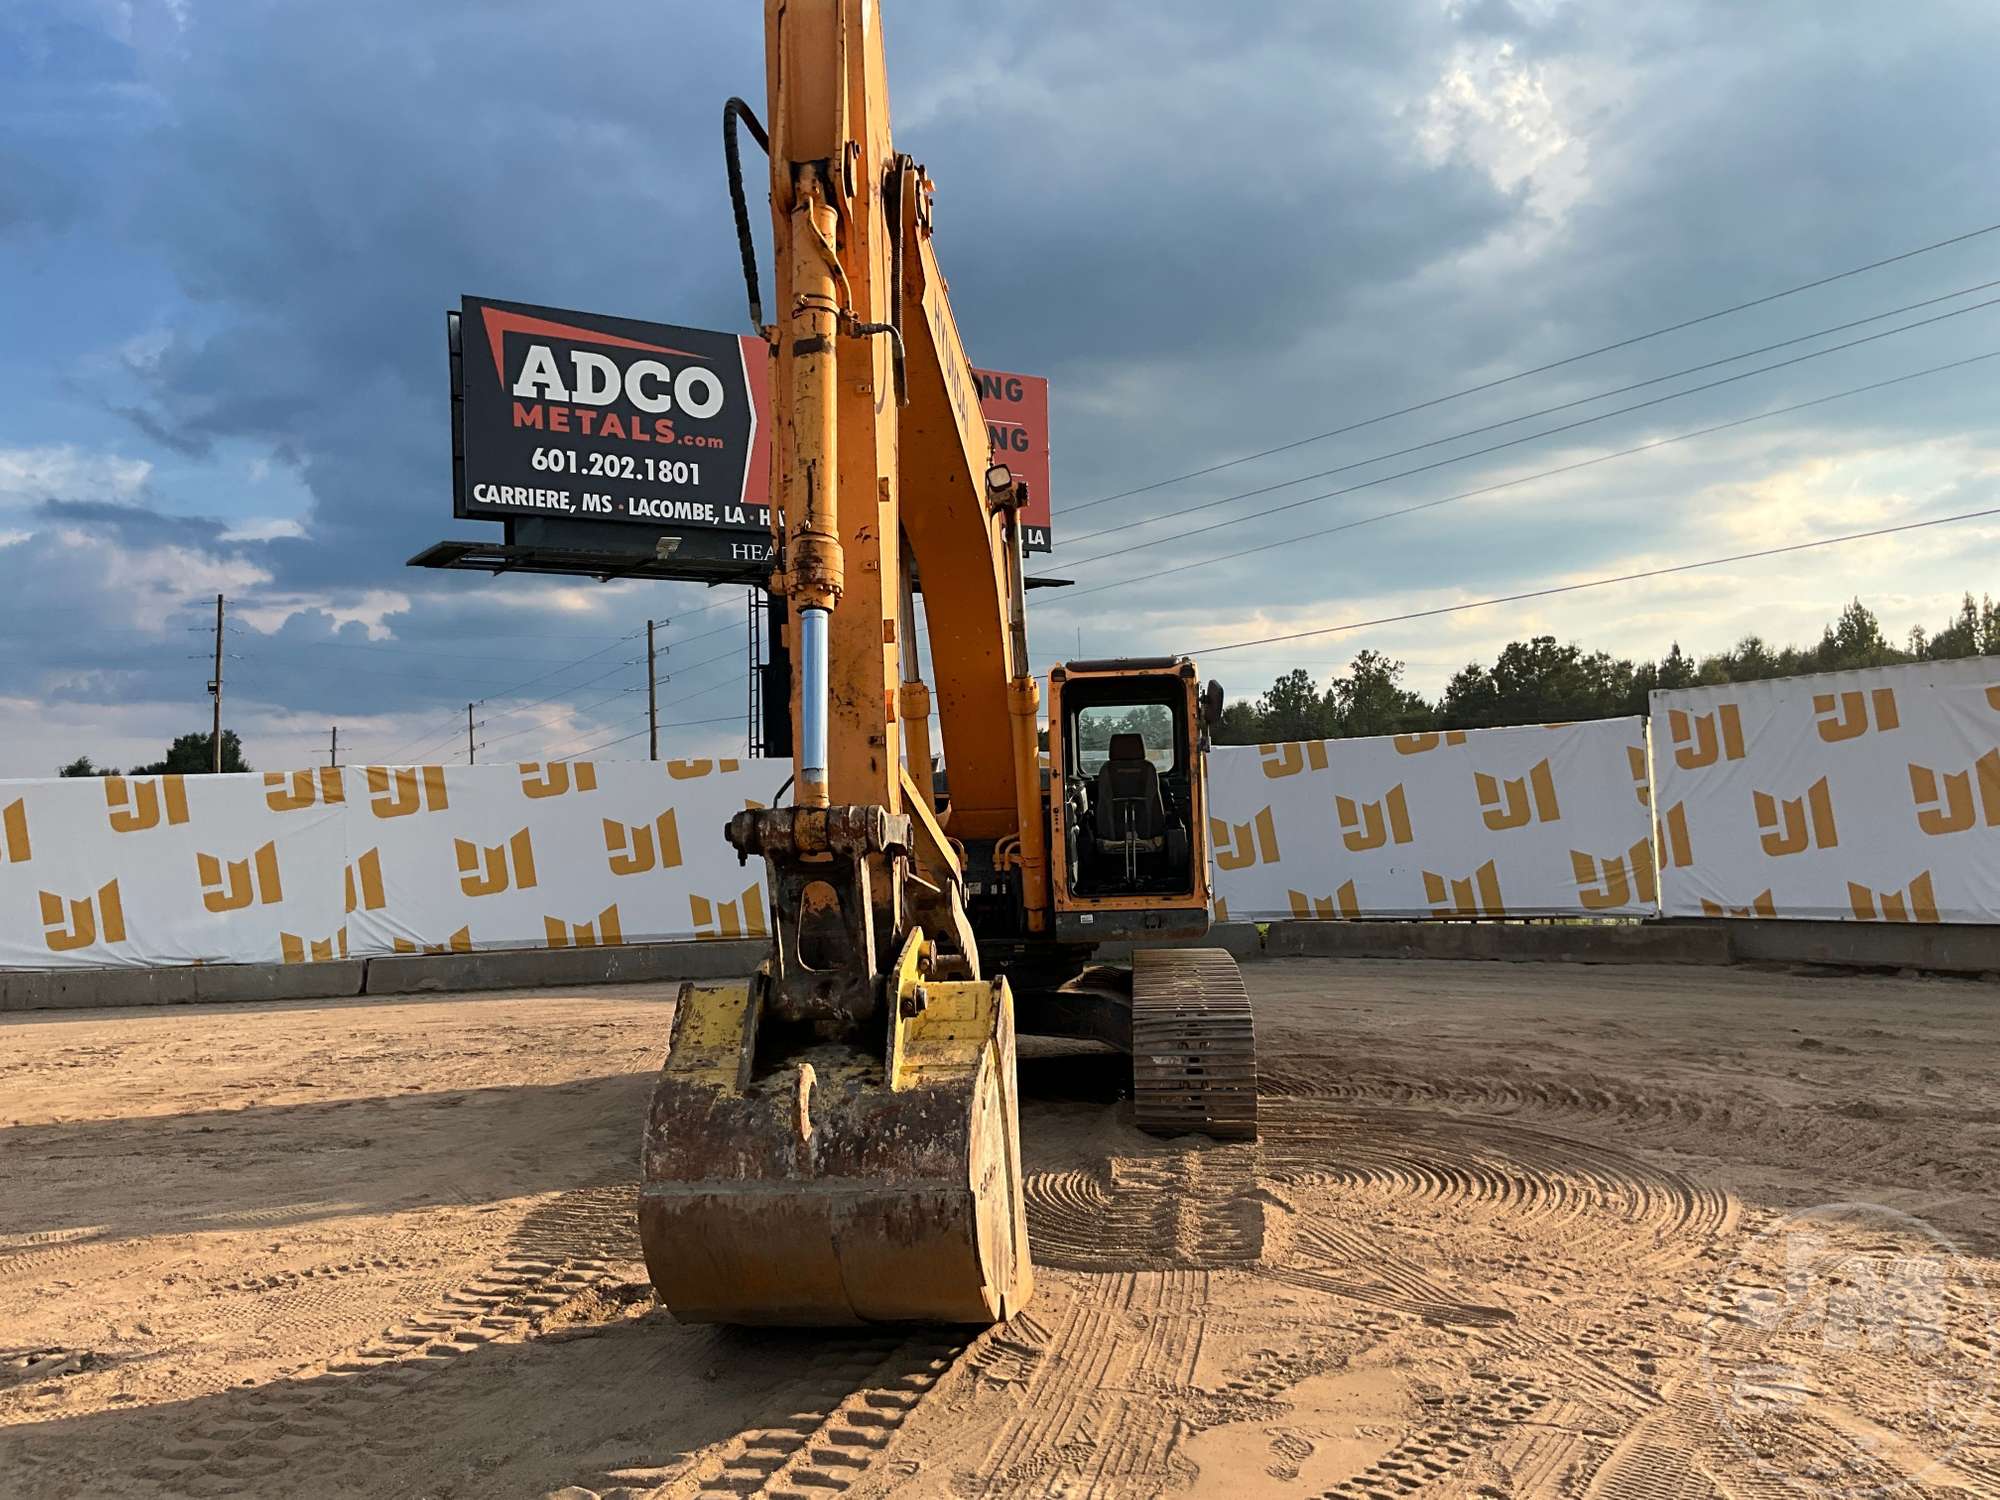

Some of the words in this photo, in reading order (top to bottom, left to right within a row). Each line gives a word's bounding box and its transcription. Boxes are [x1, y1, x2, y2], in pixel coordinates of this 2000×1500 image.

[512, 344, 725, 419] ADCO
[934, 291, 969, 440] HYUNDAI
[982, 374, 1024, 403] NG
[991, 426, 1029, 453] NG
[531, 447, 700, 486] 601.202.1801
[473, 483, 577, 514] CARRIERE,
[582, 492, 613, 513] MS
[628, 497, 720, 526] LACOMBE,
[724, 505, 746, 525] LA
[1027, 528, 1045, 545] LA
